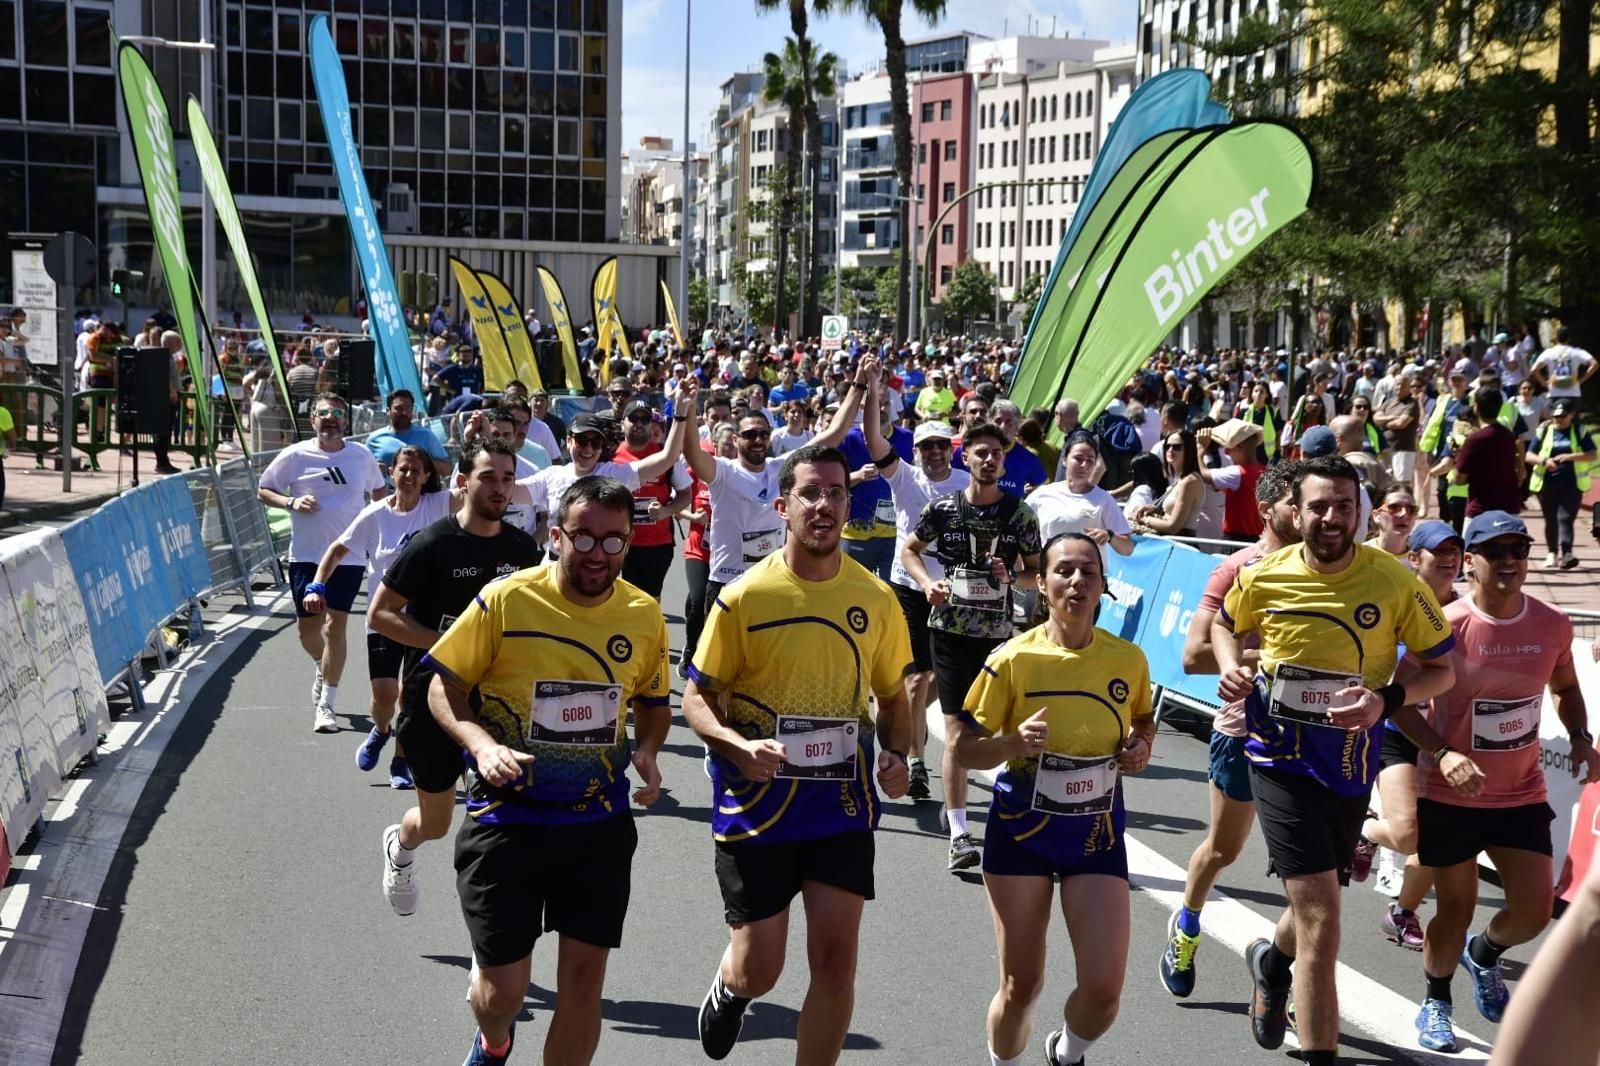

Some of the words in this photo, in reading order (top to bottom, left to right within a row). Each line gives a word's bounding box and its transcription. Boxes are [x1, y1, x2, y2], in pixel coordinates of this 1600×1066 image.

[1143, 186, 1270, 328] Binter
[971, 585, 990, 595] 3322
[1414, 591, 1444, 631] GUAGUAS
[1301, 691, 1330, 704] 6075
[562, 705, 592, 723] 6080
[1499, 718, 1523, 734] 6085
[805, 741, 833, 758] 6072
[1342, 732, 1356, 780] GUAGUA
[1066, 779, 1094, 795] 6079
